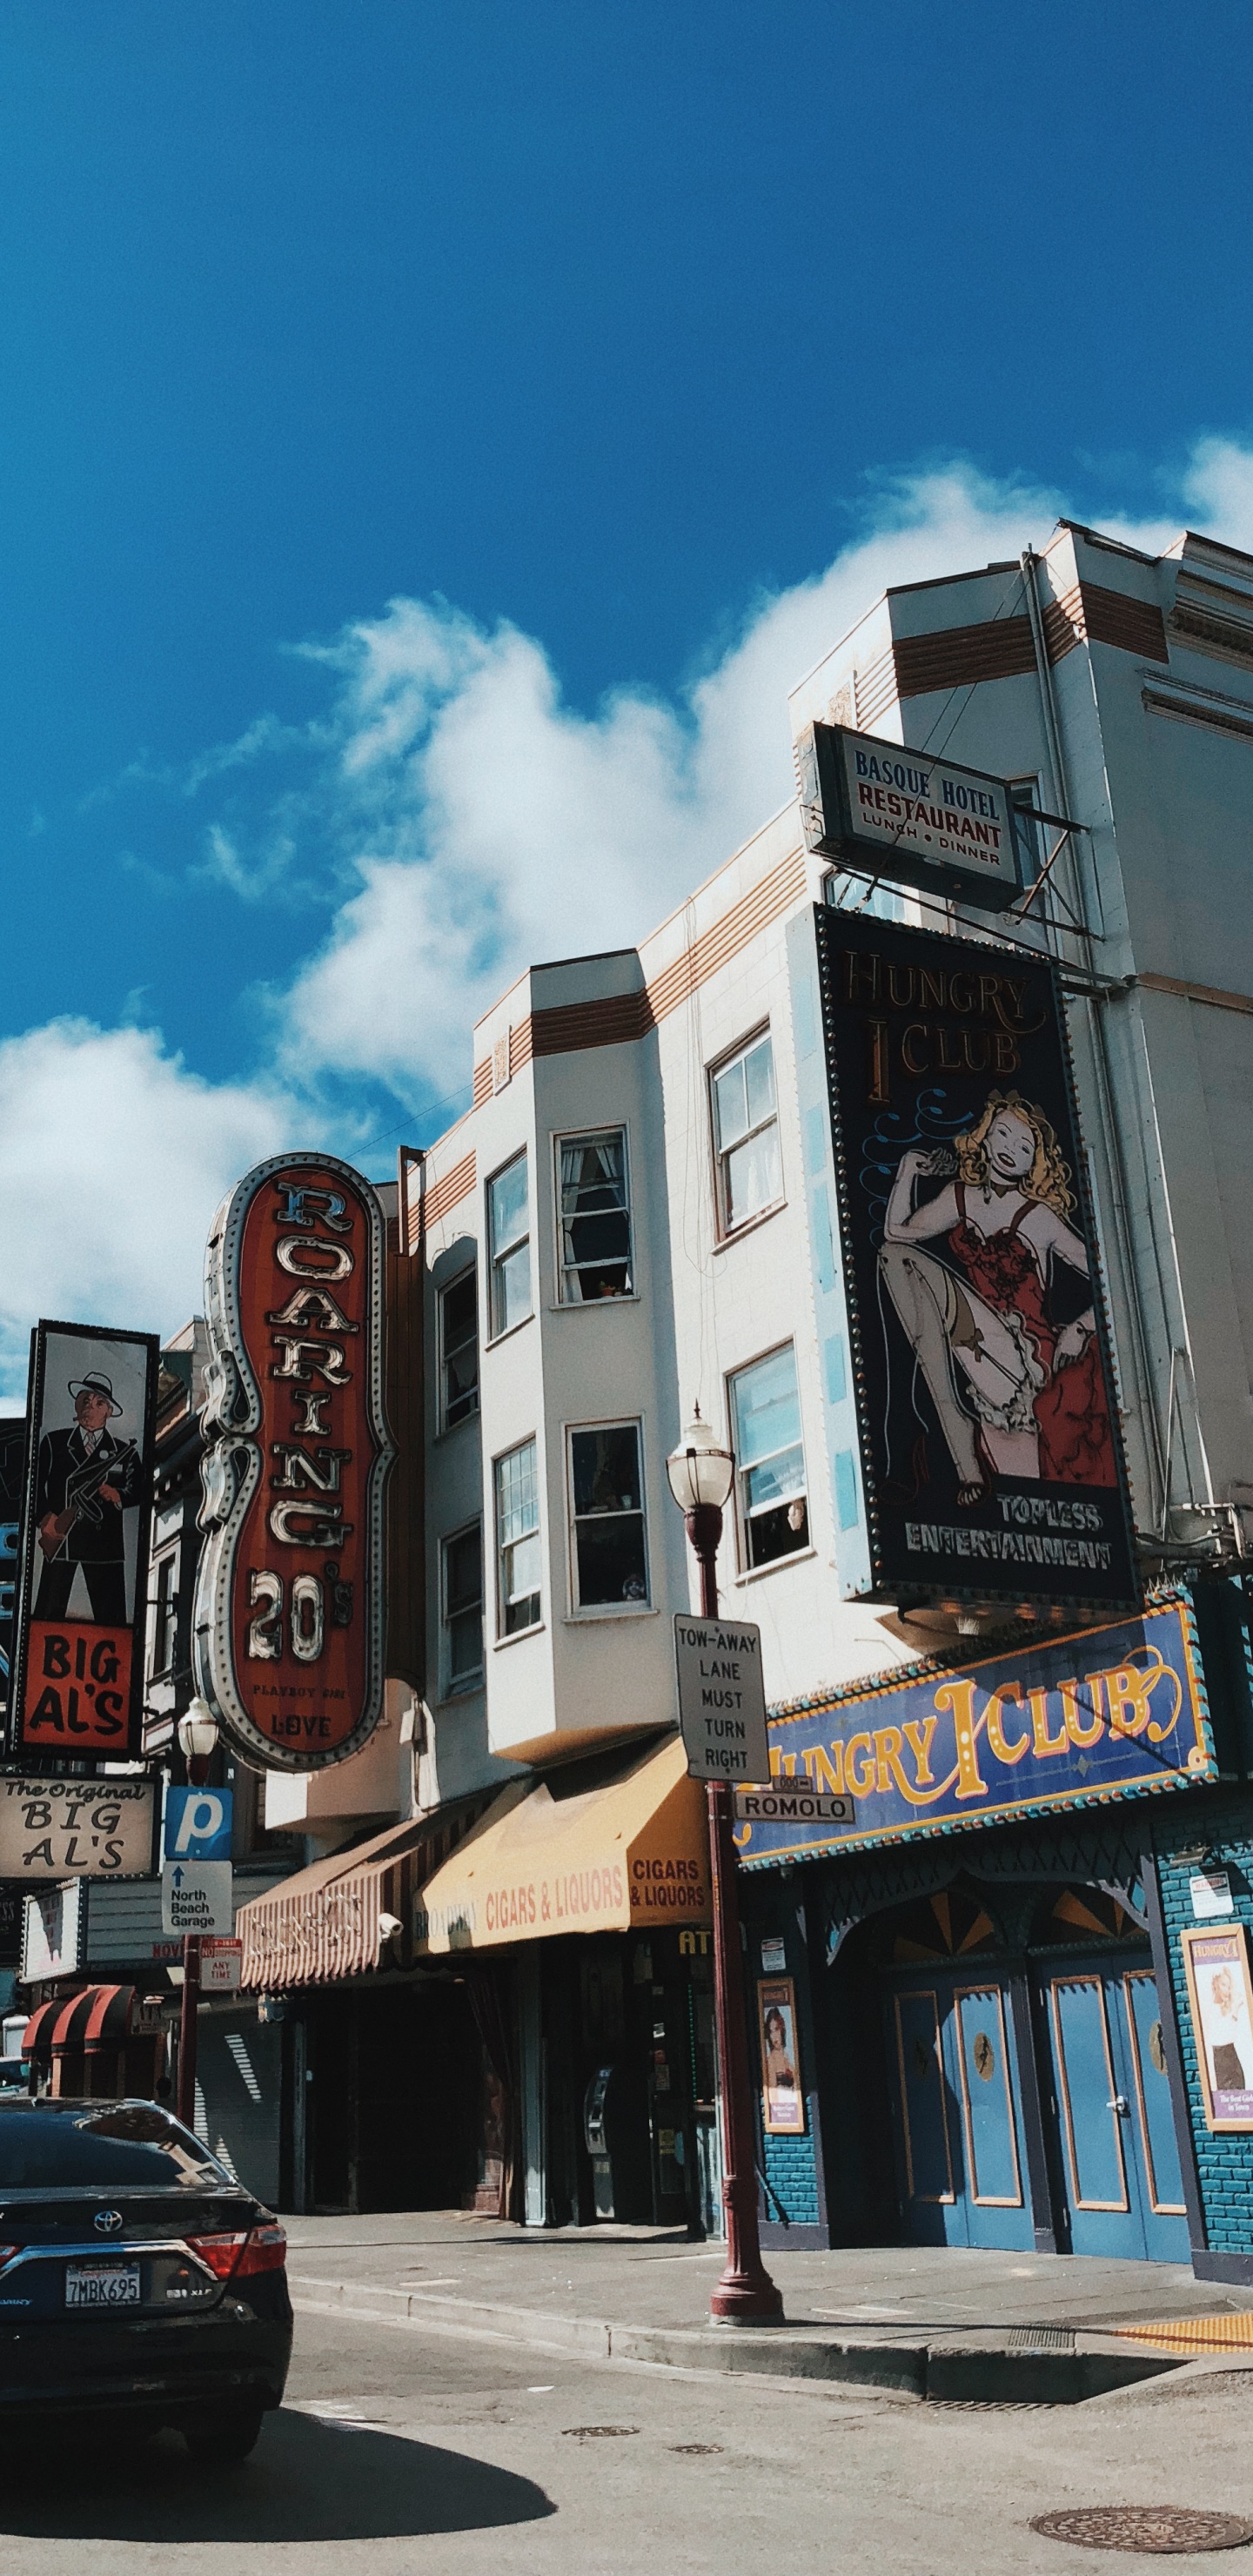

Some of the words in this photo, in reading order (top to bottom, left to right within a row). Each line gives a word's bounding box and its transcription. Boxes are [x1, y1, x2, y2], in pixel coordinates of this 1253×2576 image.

[855, 750, 930, 798] BASQUE
[941, 780, 1000, 821] HOTEL
[859, 782, 1001, 849] RESTAURANT
[863, 812, 917, 840] LUNCH
[940, 837, 1000, 865] DINNER
[842, 949, 1046, 1034] HUNGRY
[901, 1023, 1022, 1075] CLUB
[269, 1182, 358, 1547] ROARING
[996, 1493, 1104, 1532] TOPLESS
[905, 1522, 1112, 1570] ENTERTAINMENT
[679, 1627, 756, 1654] TOW-AWAY
[43, 1634, 121, 1684] BIG
[700, 1660, 740, 1680] LANE
[253, 1684, 316, 1698] PLAYBOY
[702, 1688, 742, 1709] MUST
[29, 1683, 124, 1736] AL'S
[271, 1713, 332, 1738] LOVE
[705, 1718, 745, 1739] TURN
[767, 1714, 957, 1805] UNGRY
[984, 1646, 1182, 1765] CLUB
[705, 1748, 747, 1768] RIGHT
[7, 1781, 47, 1798] The
[49, 1783, 145, 1803] Original
[22, 1801, 122, 1835] BIG
[745, 1796, 846, 1818] ROMOLO
[23, 1835, 124, 1869] AL'S
[633, 1859, 700, 1880] CIGARS
[171, 1889, 206, 1901] North
[486, 1882, 537, 1931] CIGARS
[541, 1881, 551, 1922] &
[556, 1865, 624, 1918] LIQUORS
[630, 1885, 640, 1907] &
[645, 1885, 705, 1907] LIQUORS
[171, 1902, 209, 1914] Beach
[171, 1915, 215, 1928] Garage
[202, 1947, 214, 1957] NO
[679, 1930, 711, 1955] AT
[211, 1970, 231, 1979] TIME
[212, 1961, 230, 1970] ANY
[69, 2277, 137, 2303] 7MBK695
